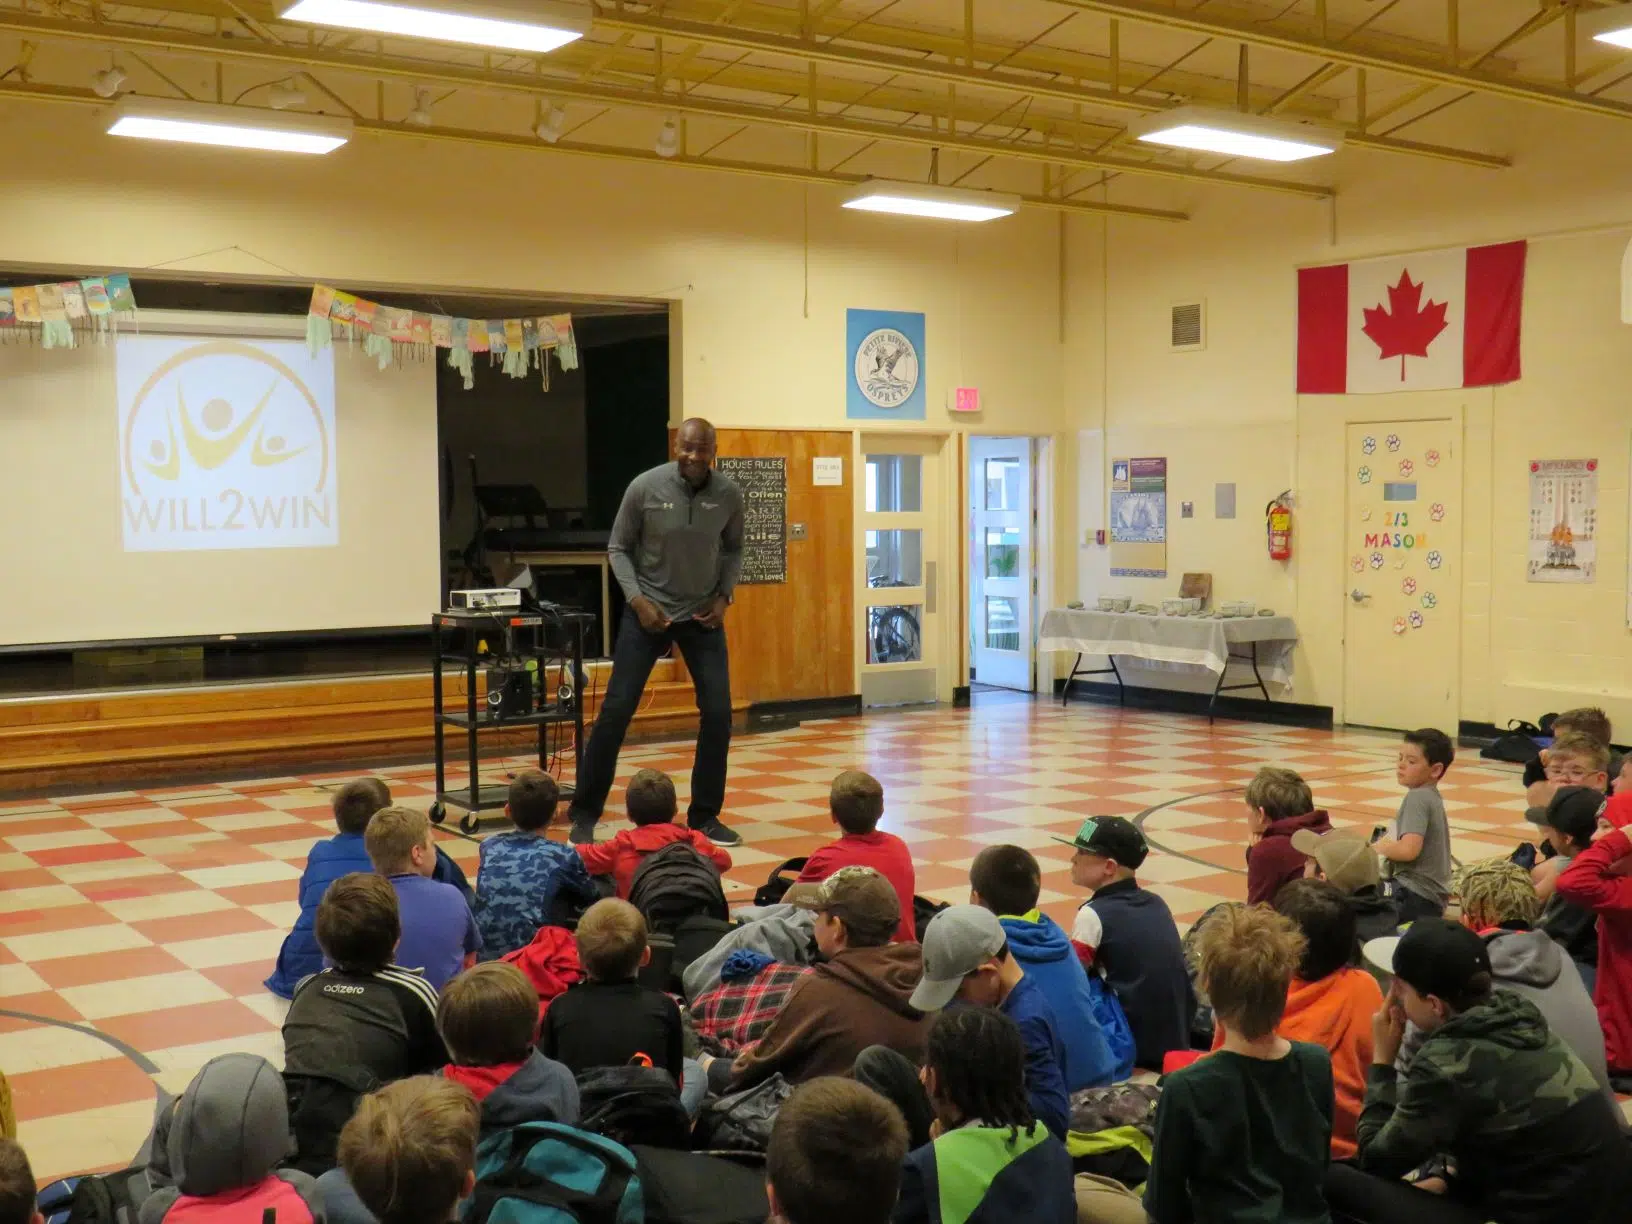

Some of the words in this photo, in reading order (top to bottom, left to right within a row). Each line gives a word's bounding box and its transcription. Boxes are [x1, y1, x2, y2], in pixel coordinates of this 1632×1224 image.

[867, 383, 909, 402] OSPREYS
[722, 460, 753, 469] HOUSE
[755, 460, 784, 469] RULES
[124, 488, 330, 532] WILL2WIN
[1384, 512, 1409, 527] 2/3
[1364, 532, 1426, 548] MASON
[323, 984, 365, 994] adizero
